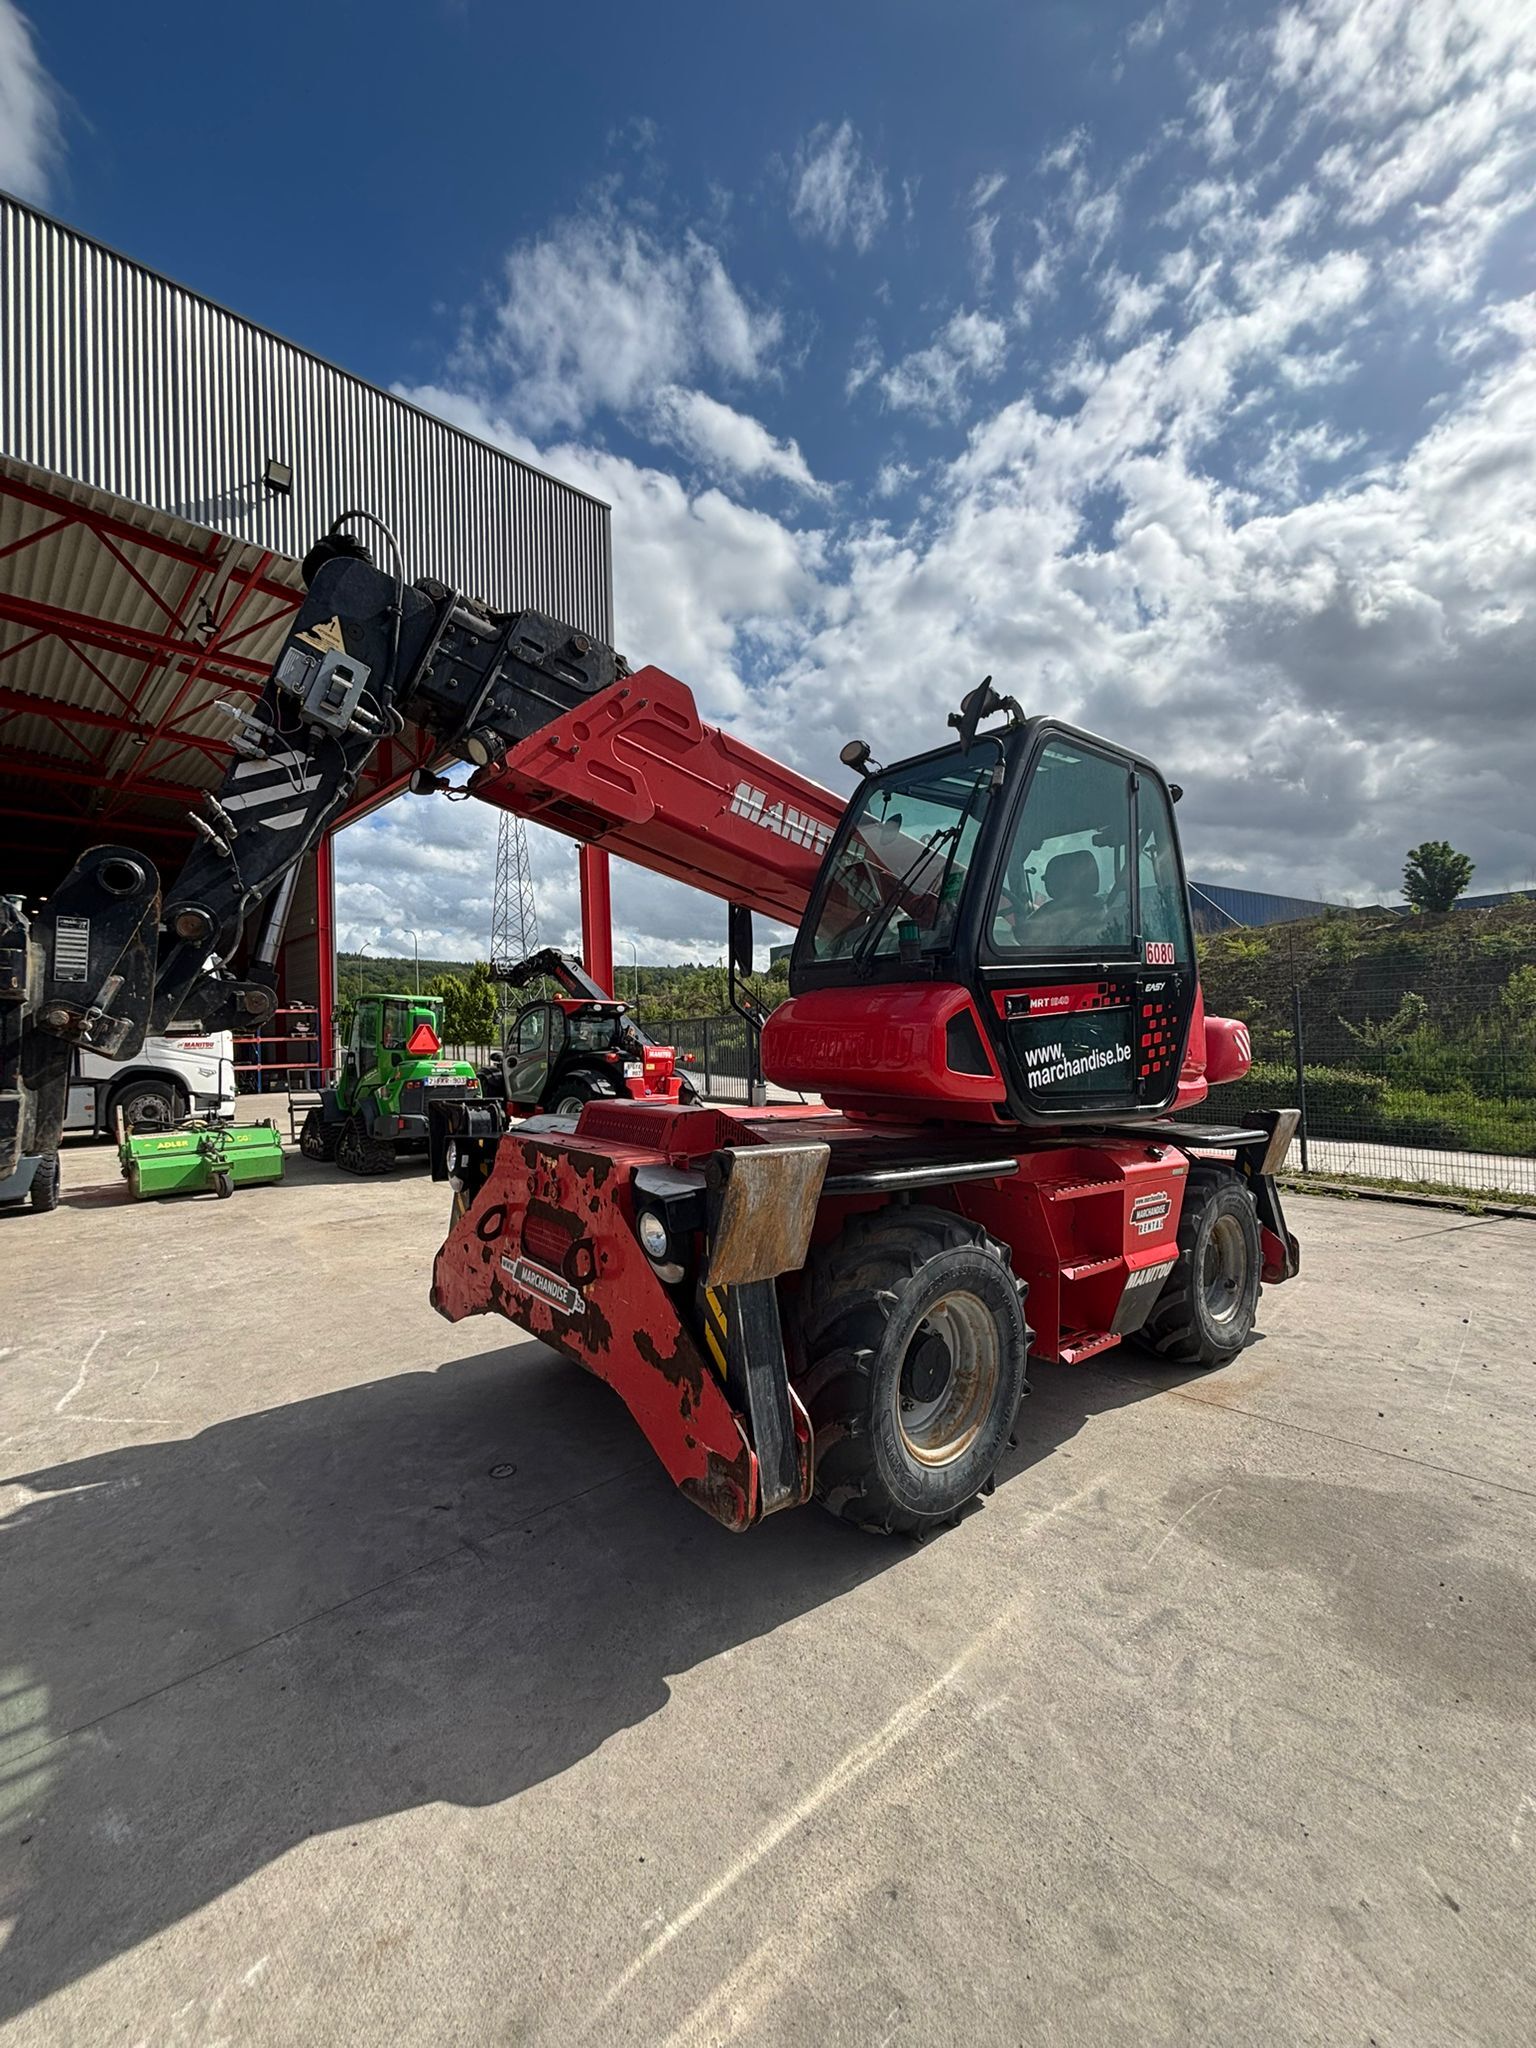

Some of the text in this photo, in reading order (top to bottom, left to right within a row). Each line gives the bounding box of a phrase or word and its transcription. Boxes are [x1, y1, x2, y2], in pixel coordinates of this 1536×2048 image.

[730, 779, 837, 857] MANIT
[1147, 943, 1174, 963] 6080
[1145, 982, 1166, 992] EASY
[1030, 997, 1050, 1009] MRT
[1025, 1042, 1065, 1068] www.
[1028, 1042, 1132, 1089] marchandise.be
[157, 1140, 189, 1149] ADLER
[521, 1267, 569, 1303] MARCHANDISE
[1125, 1260, 1175, 1290] MANITOU
